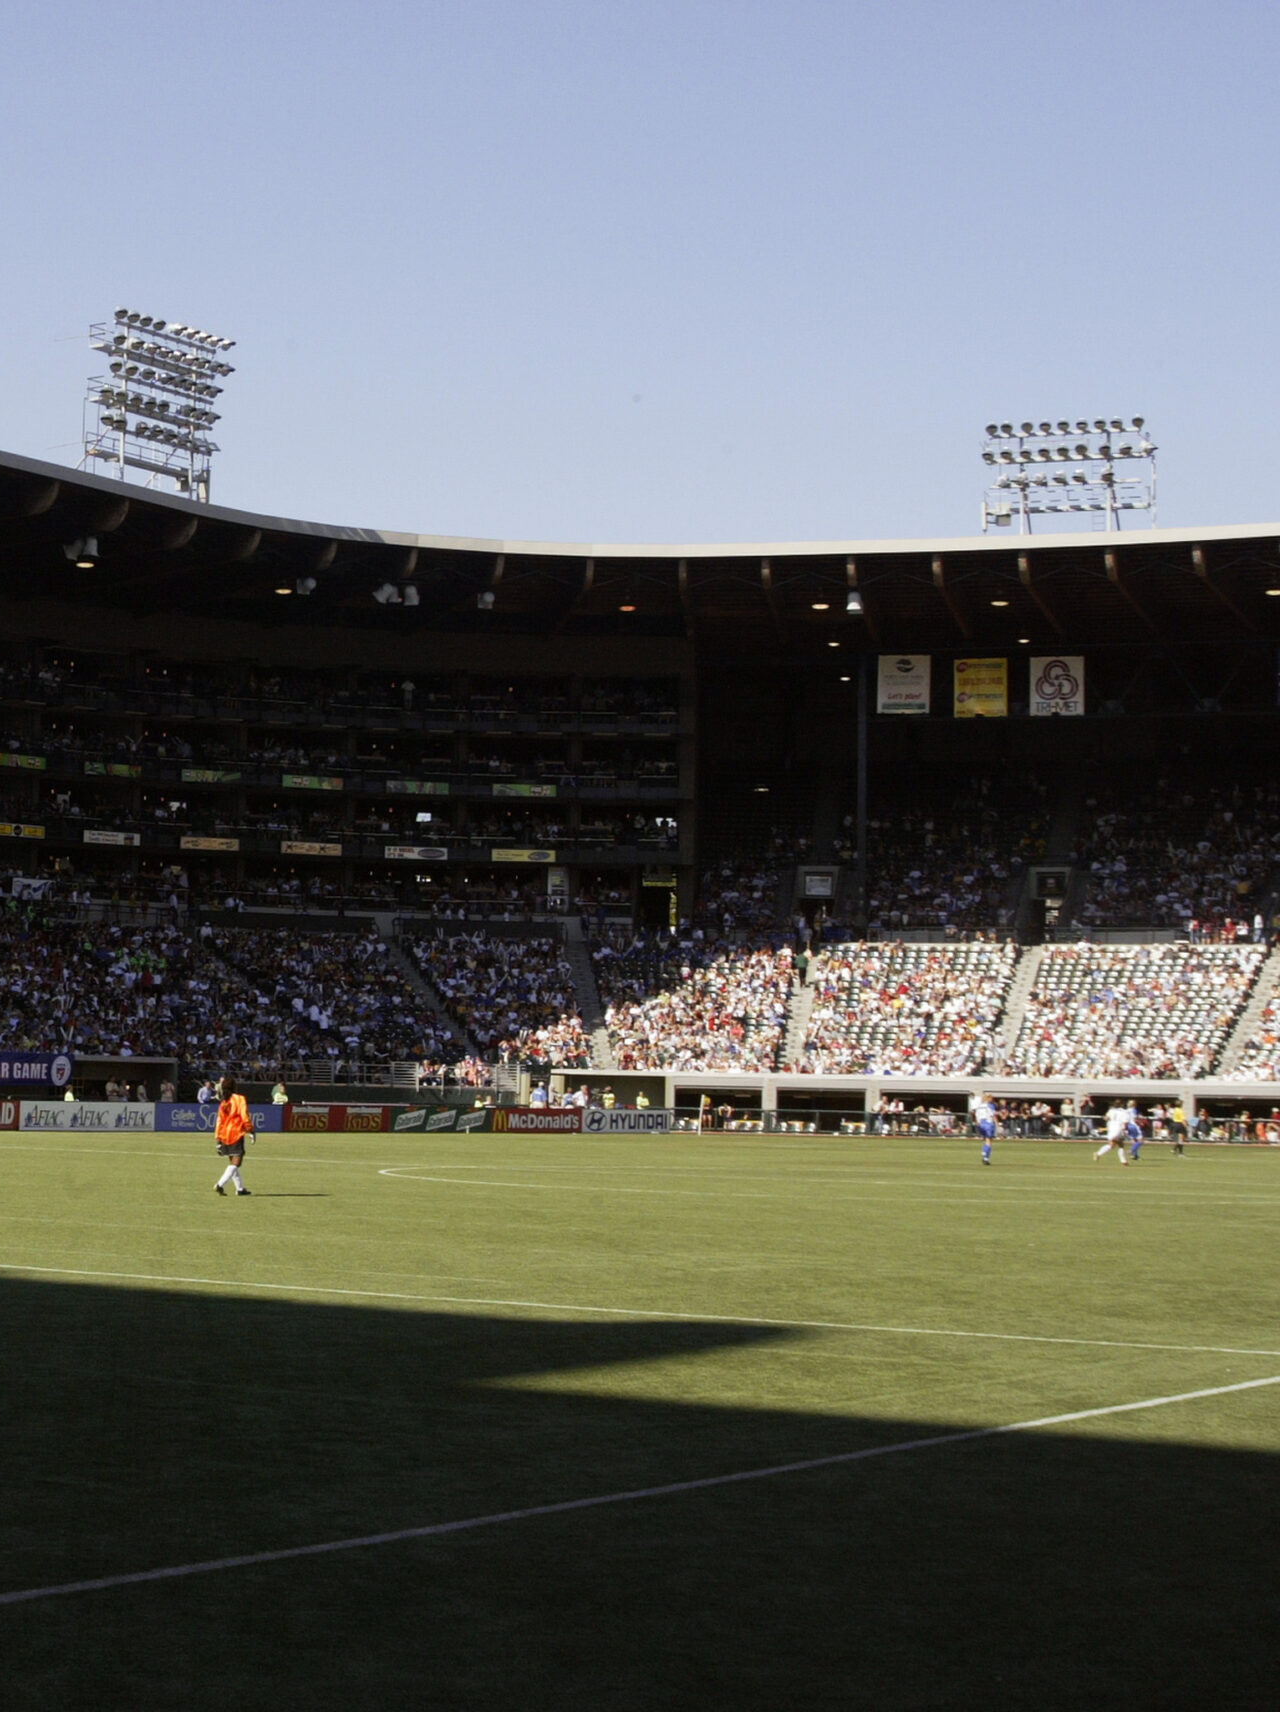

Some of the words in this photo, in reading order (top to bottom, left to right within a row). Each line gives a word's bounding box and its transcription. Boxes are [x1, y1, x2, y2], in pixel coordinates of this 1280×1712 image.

[12, 1062, 49, 1081] GAME
[32, 1104, 65, 1126] AFLAC
[77, 1105, 110, 1127] AFLAC
[122, 1106, 153, 1128] AFLAC
[290, 1113, 329, 1131] KIDS
[344, 1113, 383, 1131] KIDS
[508, 1112, 580, 1130] McDonald's
[610, 1113, 668, 1130] HYUNDAI
